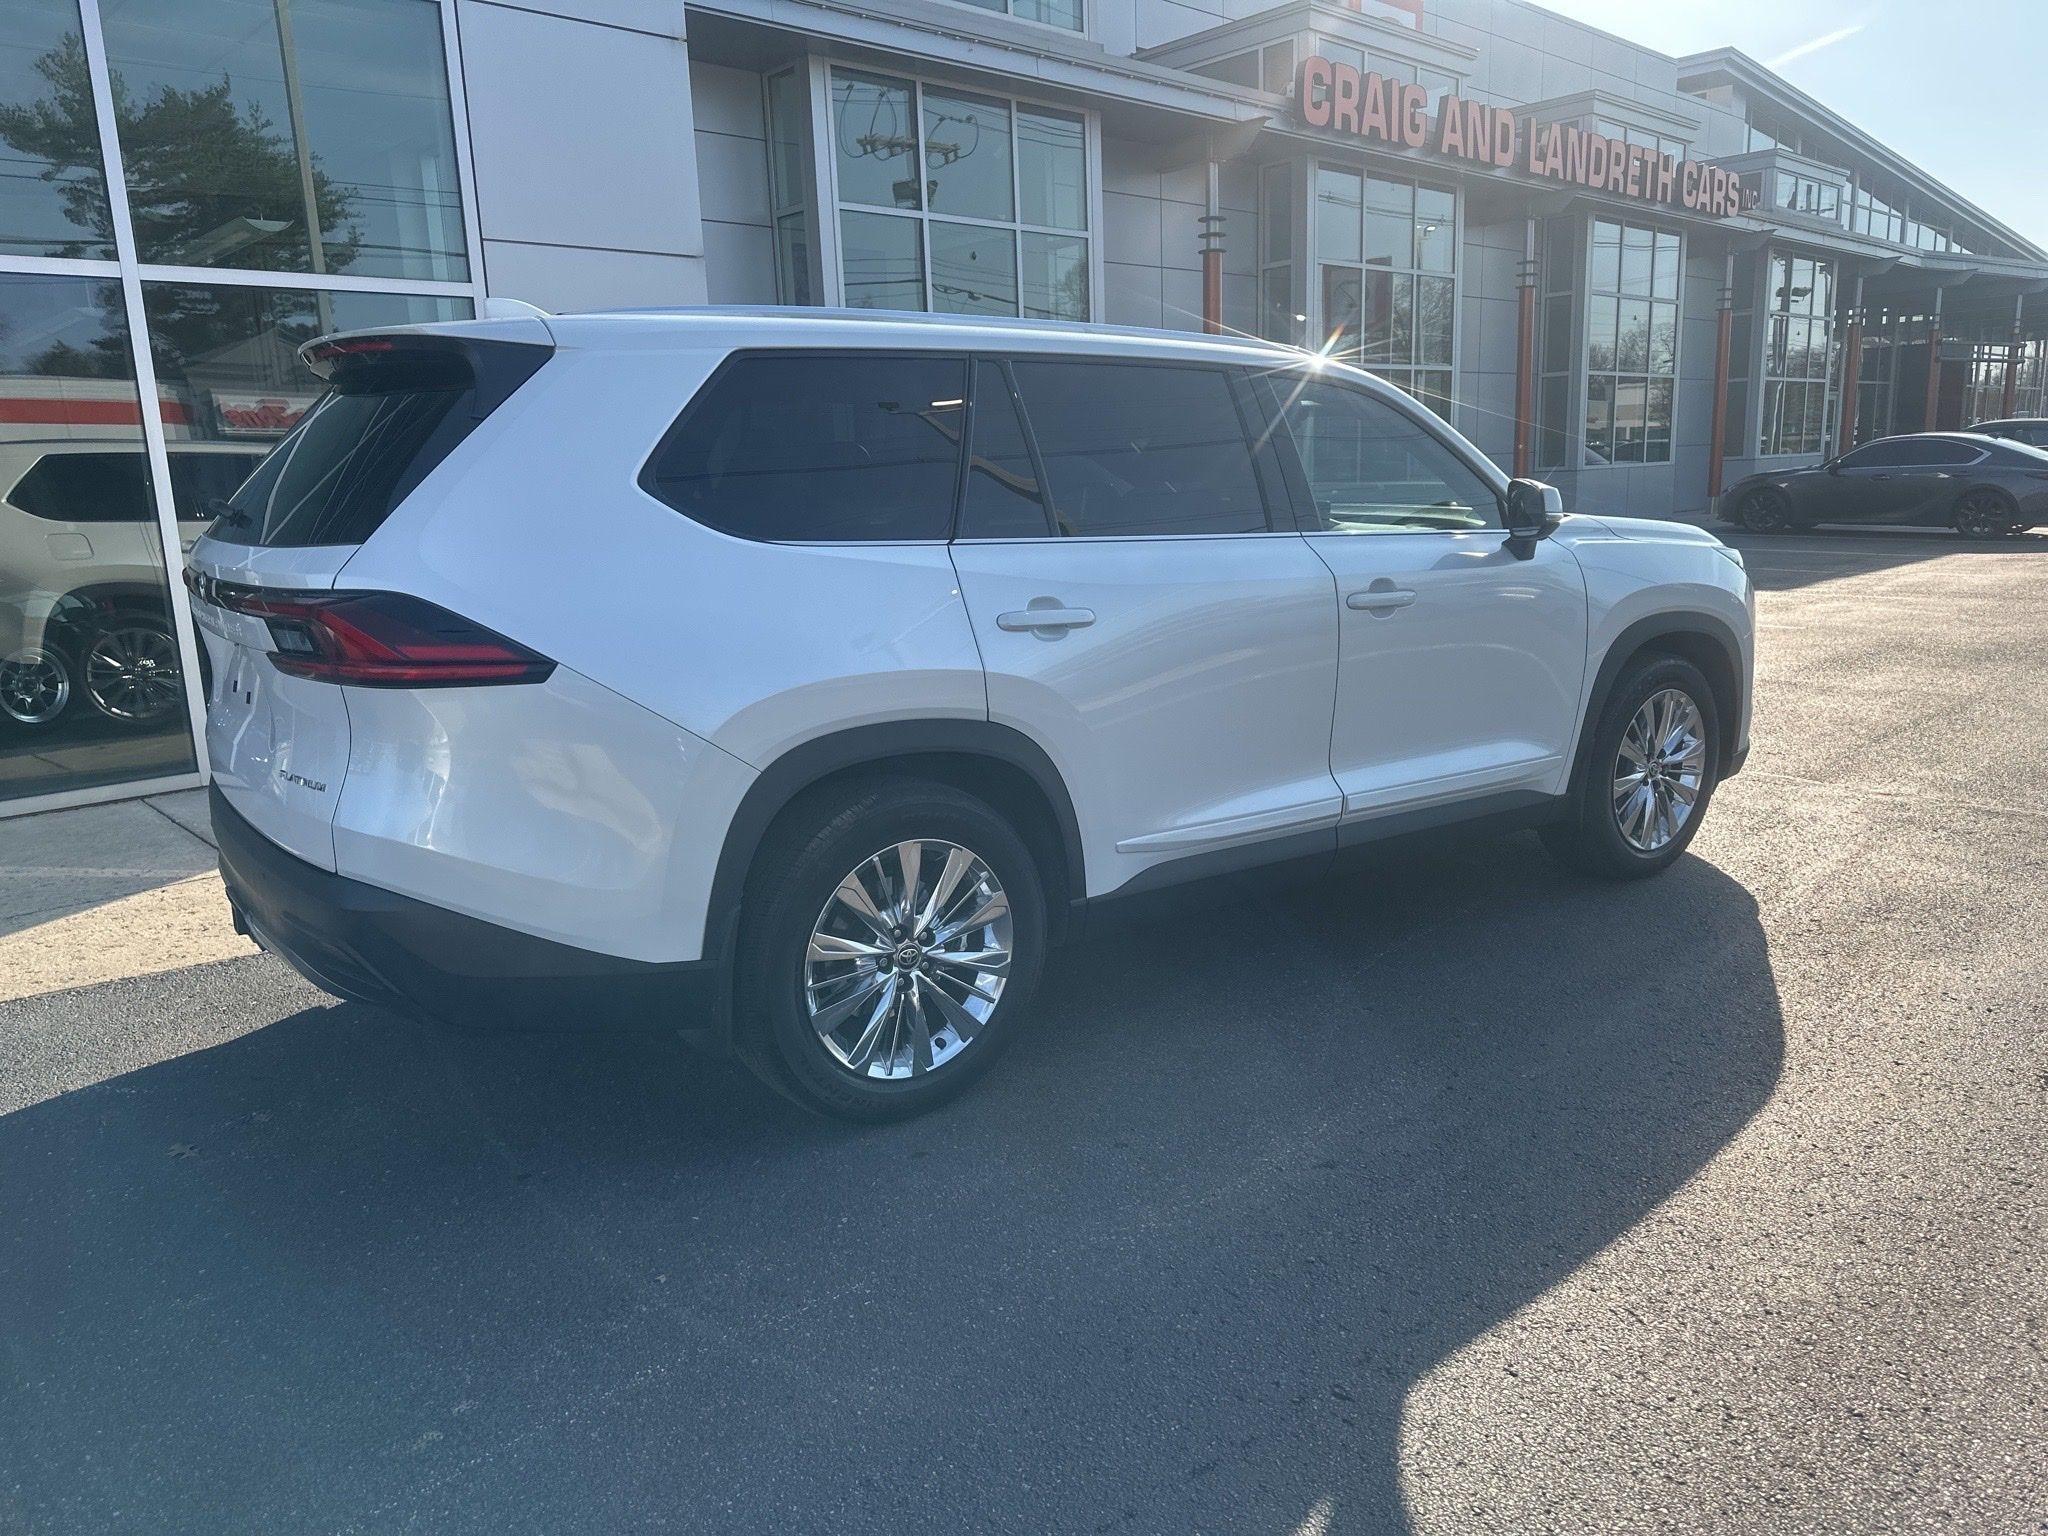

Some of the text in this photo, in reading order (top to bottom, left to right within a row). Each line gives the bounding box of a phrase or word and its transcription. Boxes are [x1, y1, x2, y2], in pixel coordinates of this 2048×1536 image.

[1302, 55, 1429, 148] CRAIG
[1440, 93, 1517, 168] AND
[1528, 116, 1675, 202] LANDRETH
[1682, 159, 1740, 218] CARS
